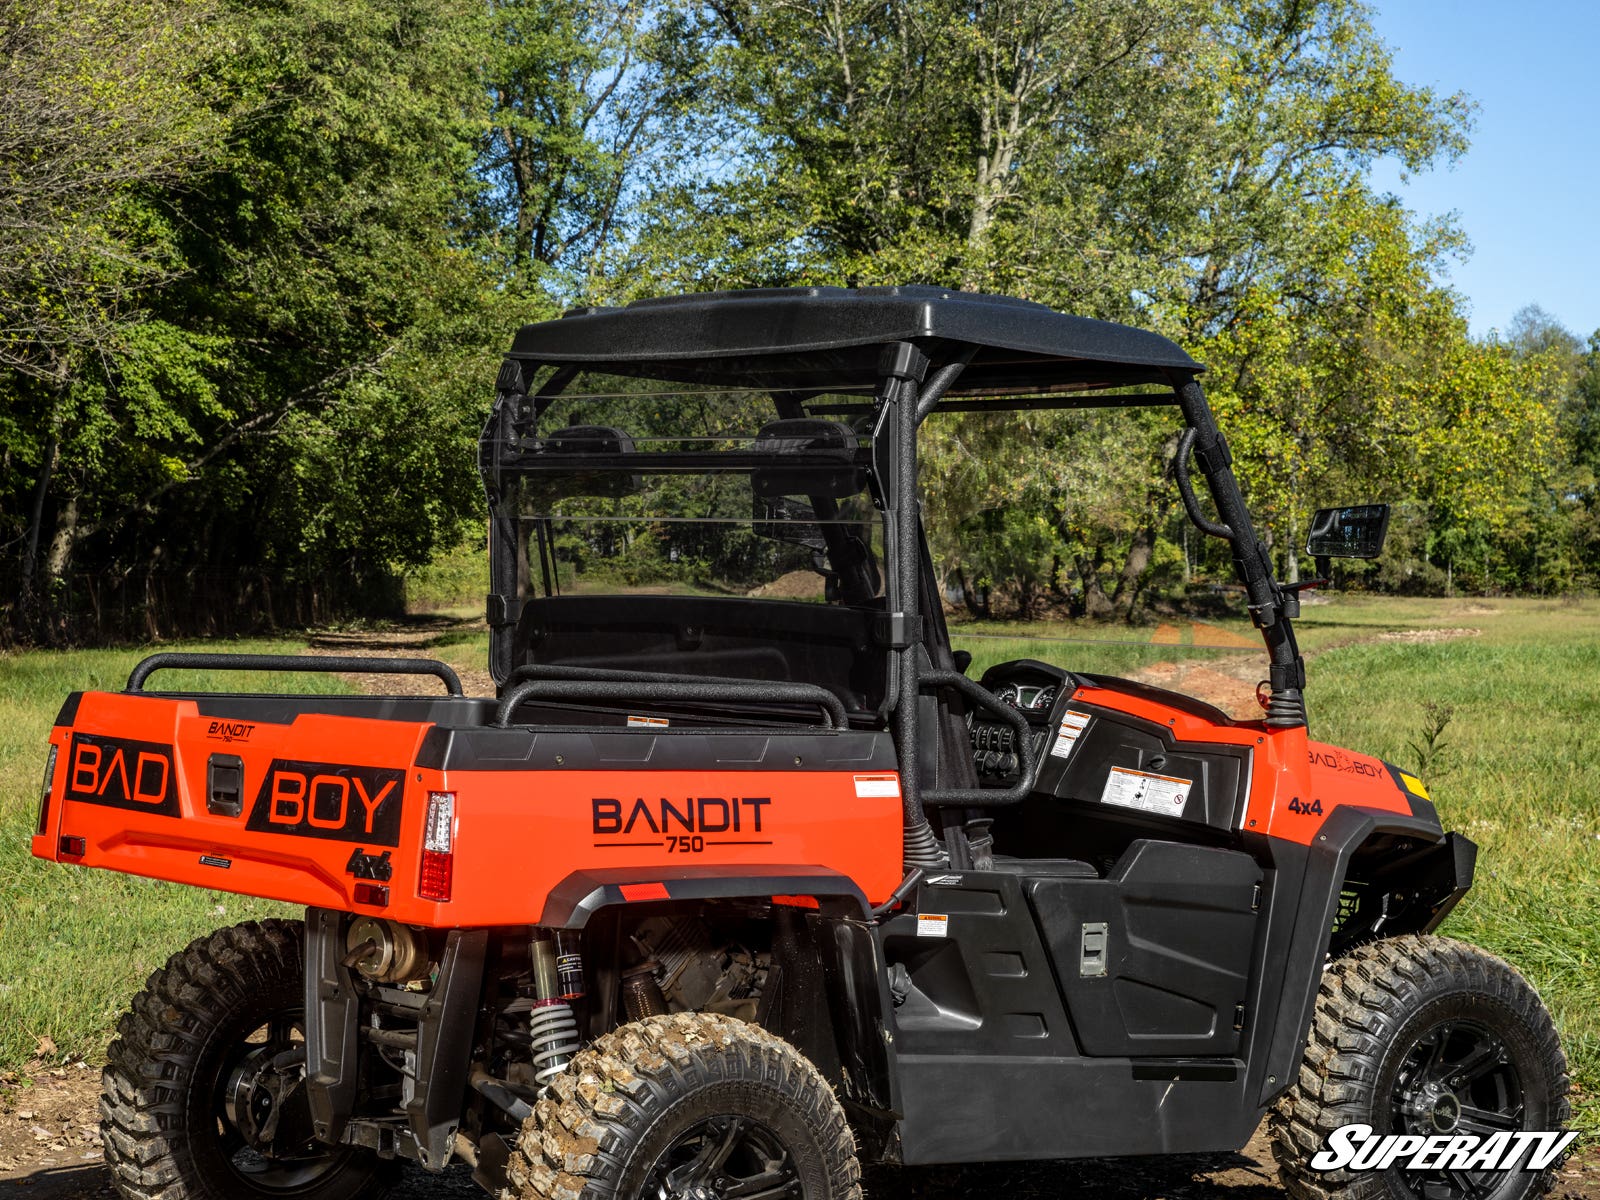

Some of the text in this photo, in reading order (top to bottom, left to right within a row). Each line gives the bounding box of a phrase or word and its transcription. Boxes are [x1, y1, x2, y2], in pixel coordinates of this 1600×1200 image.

[208, 721, 256, 737] BANDIT
[1352, 761, 1383, 779] BOY
[71, 743, 398, 833] BAD BOY
[591, 797, 772, 834] BANDIT
[1288, 796, 1324, 816] 4x4
[666, 836, 704, 854] 750
